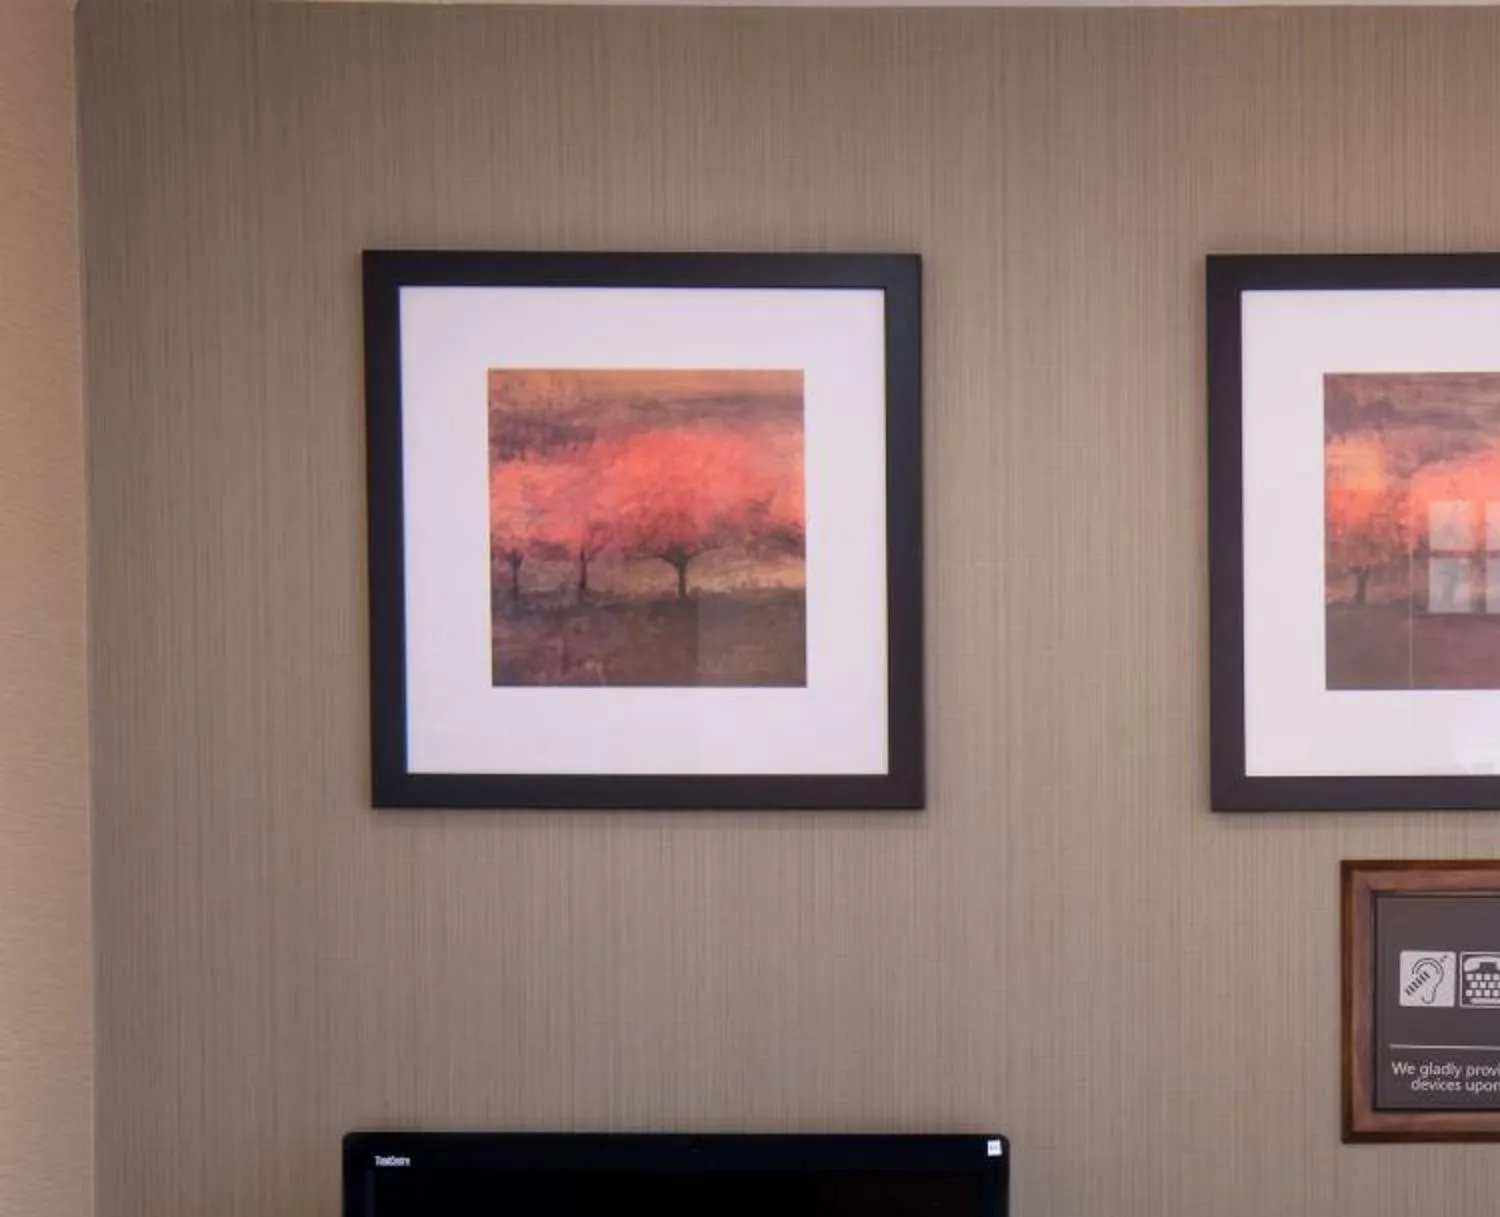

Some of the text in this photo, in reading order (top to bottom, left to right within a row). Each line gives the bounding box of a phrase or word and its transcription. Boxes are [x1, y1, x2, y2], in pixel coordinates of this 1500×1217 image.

[1391, 1061, 1415, 1076] We
[1419, 1061, 1462, 1079] gladly
[1411, 1077, 1462, 1093] devices
